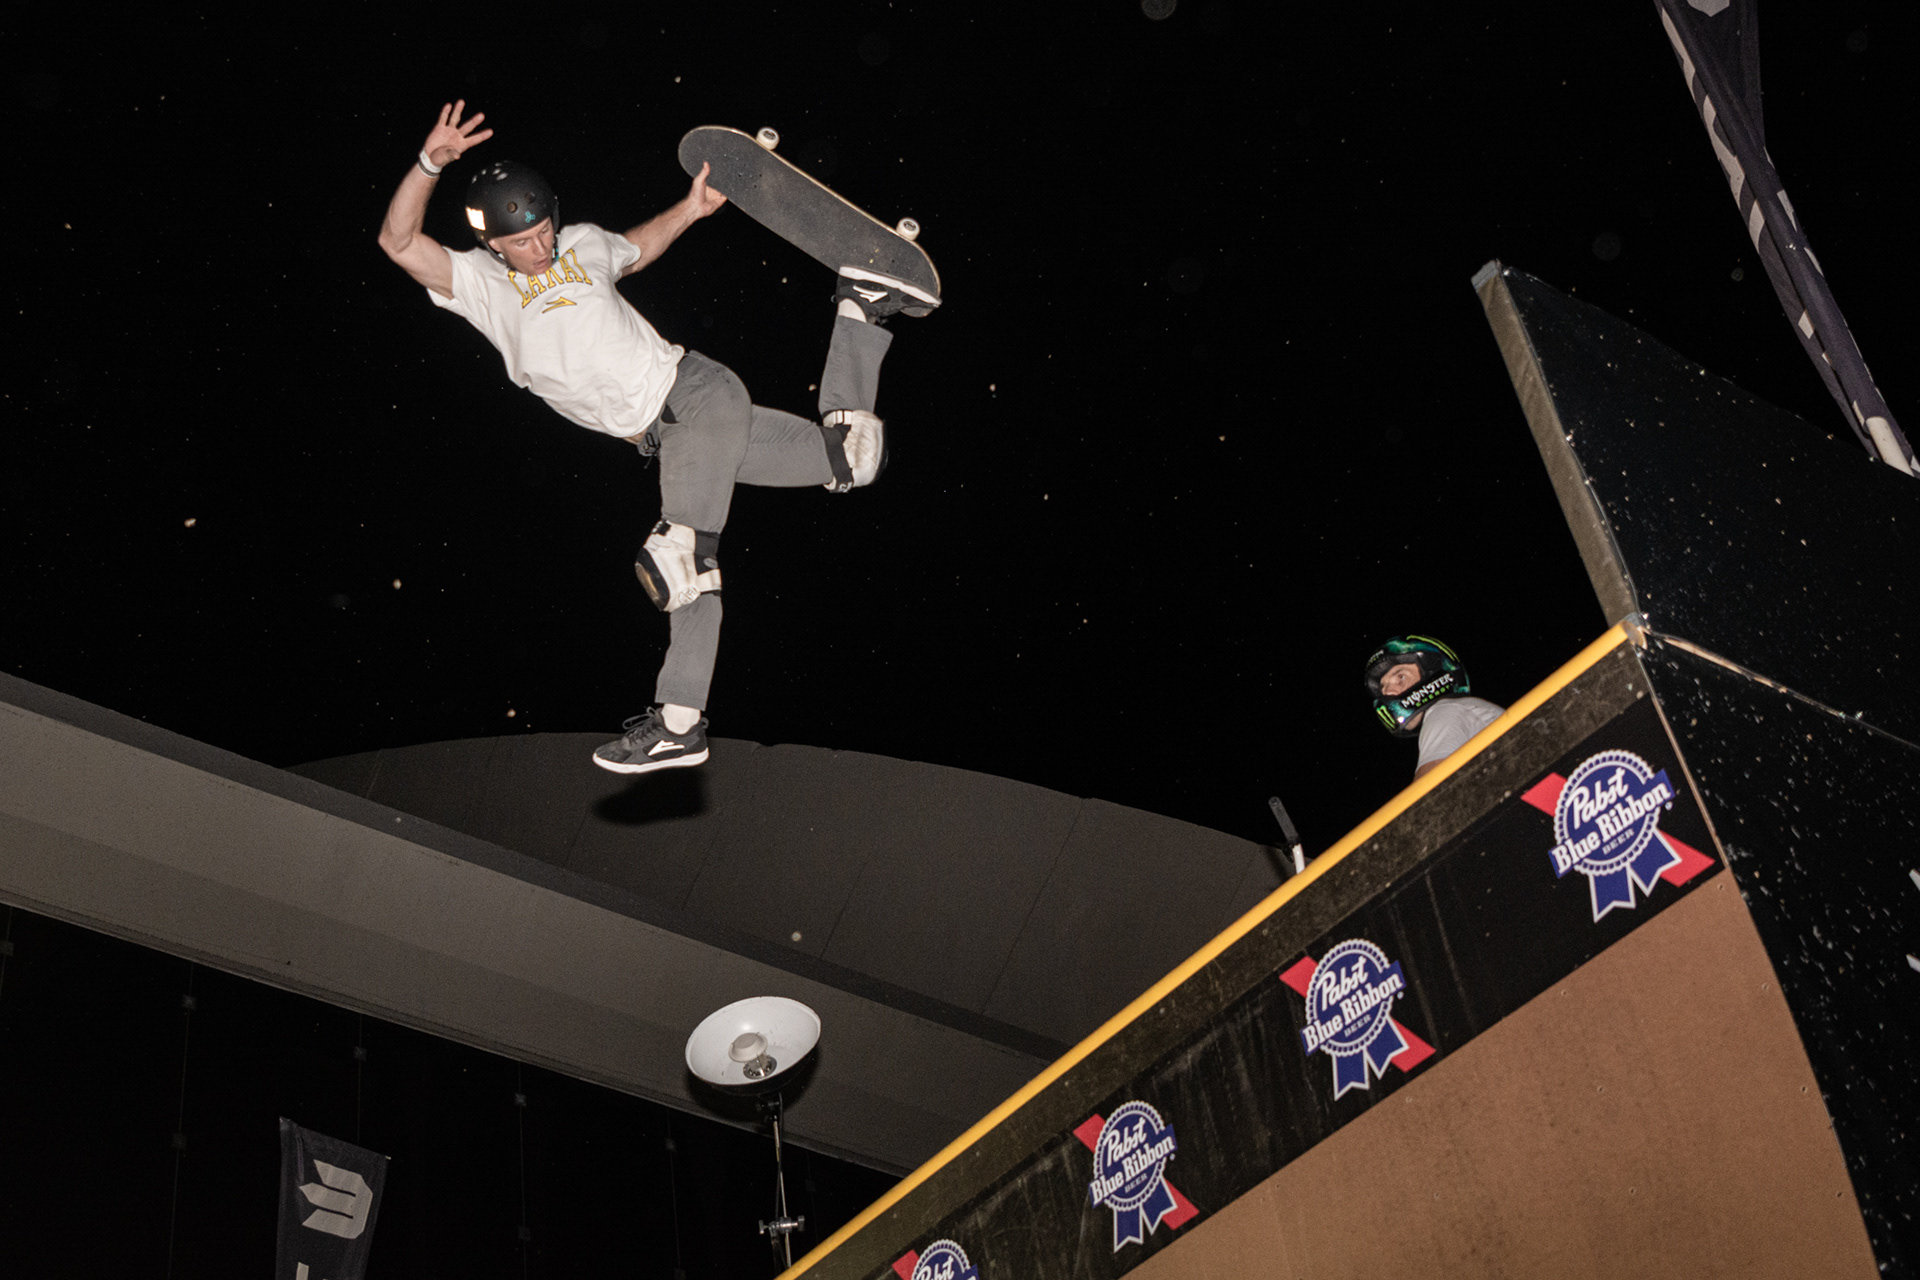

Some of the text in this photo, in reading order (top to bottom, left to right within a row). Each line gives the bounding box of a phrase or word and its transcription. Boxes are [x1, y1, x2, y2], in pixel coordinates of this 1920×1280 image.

[1401, 673, 1454, 708] MONSTER
[1566, 767, 1629, 830] Pabst
[1552, 783, 1671, 874] Blue Ribbon
[1602, 828, 1635, 855] BEER
[1315, 955, 1368, 1011] Pabst
[1302, 973, 1403, 1053] Blue Ribbon
[1089, 1136, 1175, 1205] Blue Ribbon
[1102, 1116, 1147, 1167] Pabst
